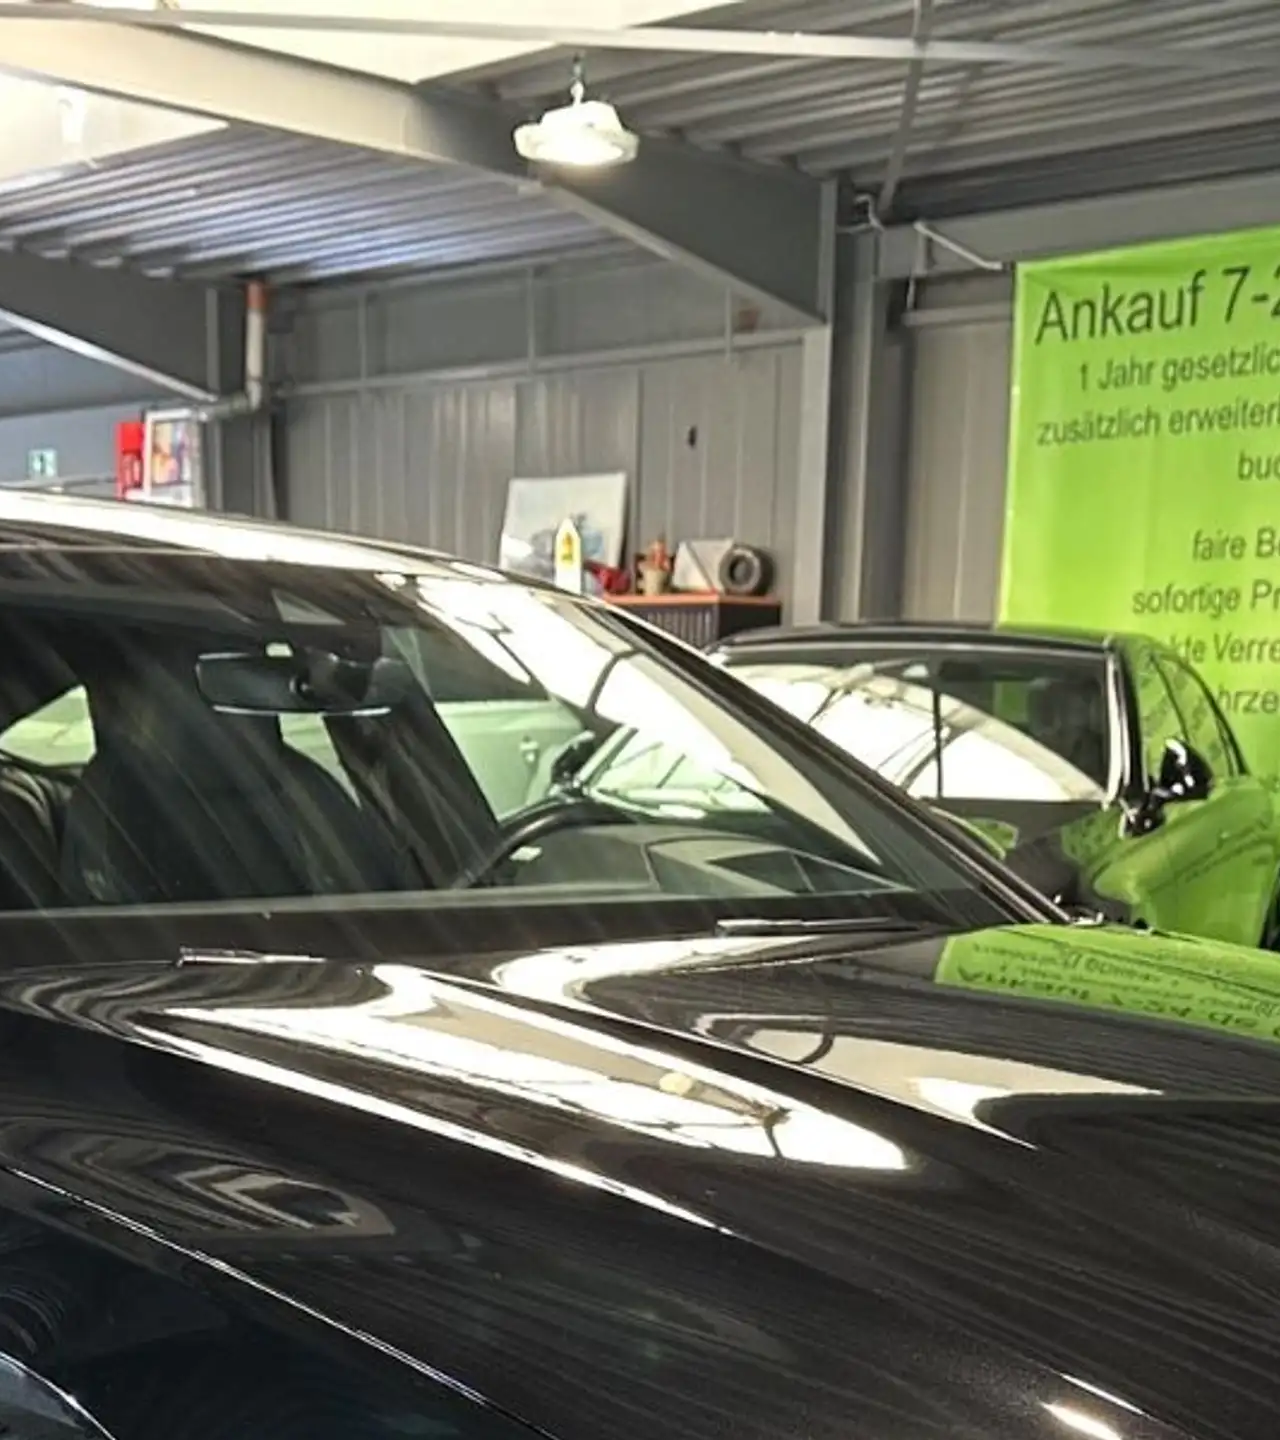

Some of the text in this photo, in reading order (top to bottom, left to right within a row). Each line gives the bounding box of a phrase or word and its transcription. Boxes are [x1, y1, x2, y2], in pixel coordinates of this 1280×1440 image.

[1035, 268, 1207, 346] Ankauf
[1097, 357, 1154, 392] Jahr
[1037, 403, 1162, 446] zusätzlich
[1192, 529, 1247, 562] faire
[1132, 583, 1242, 619] sofortige
